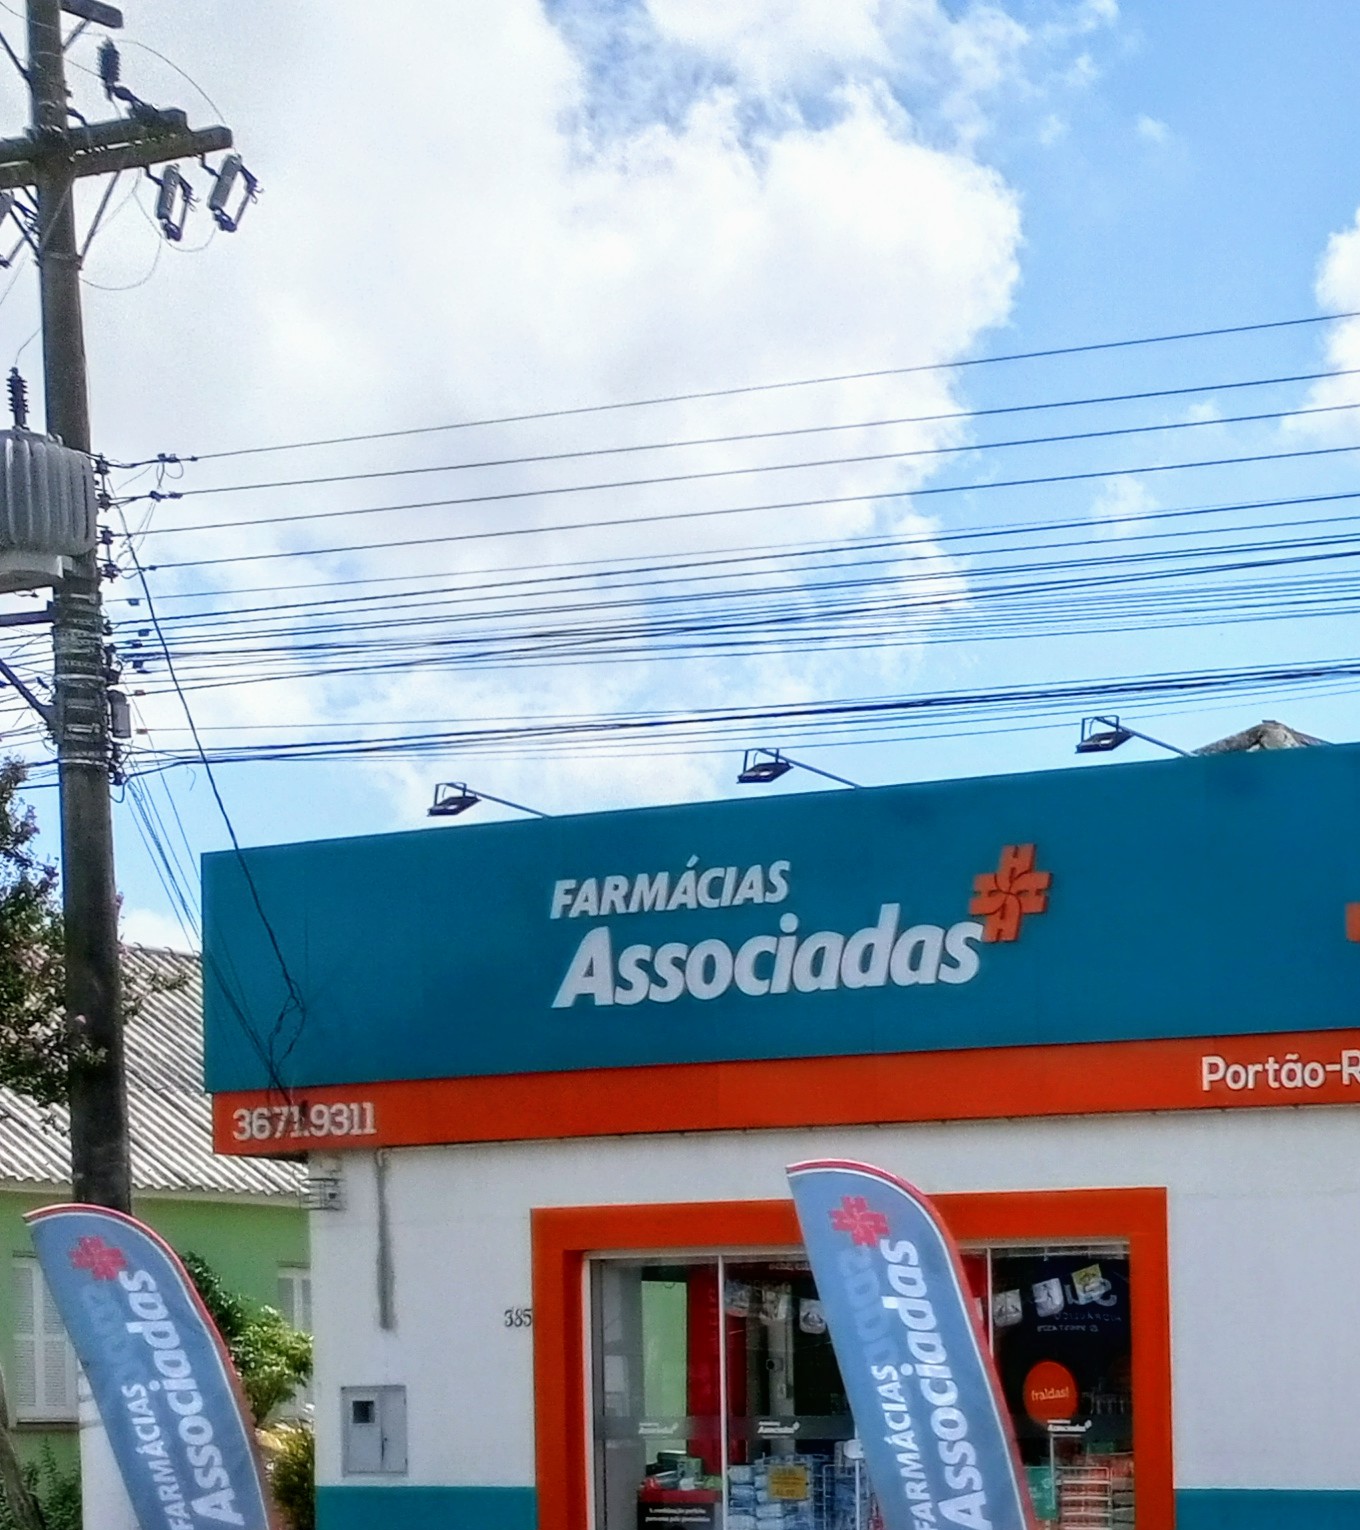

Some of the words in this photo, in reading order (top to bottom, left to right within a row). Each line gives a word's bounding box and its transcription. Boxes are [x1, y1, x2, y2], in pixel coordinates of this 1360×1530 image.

[550, 856, 790, 920] FARMÁCIAS
[550, 903, 984, 1009] Associadas
[232, 1102, 377, 1140] 3671.9311
[118, 1268, 246, 1528] Associadas
